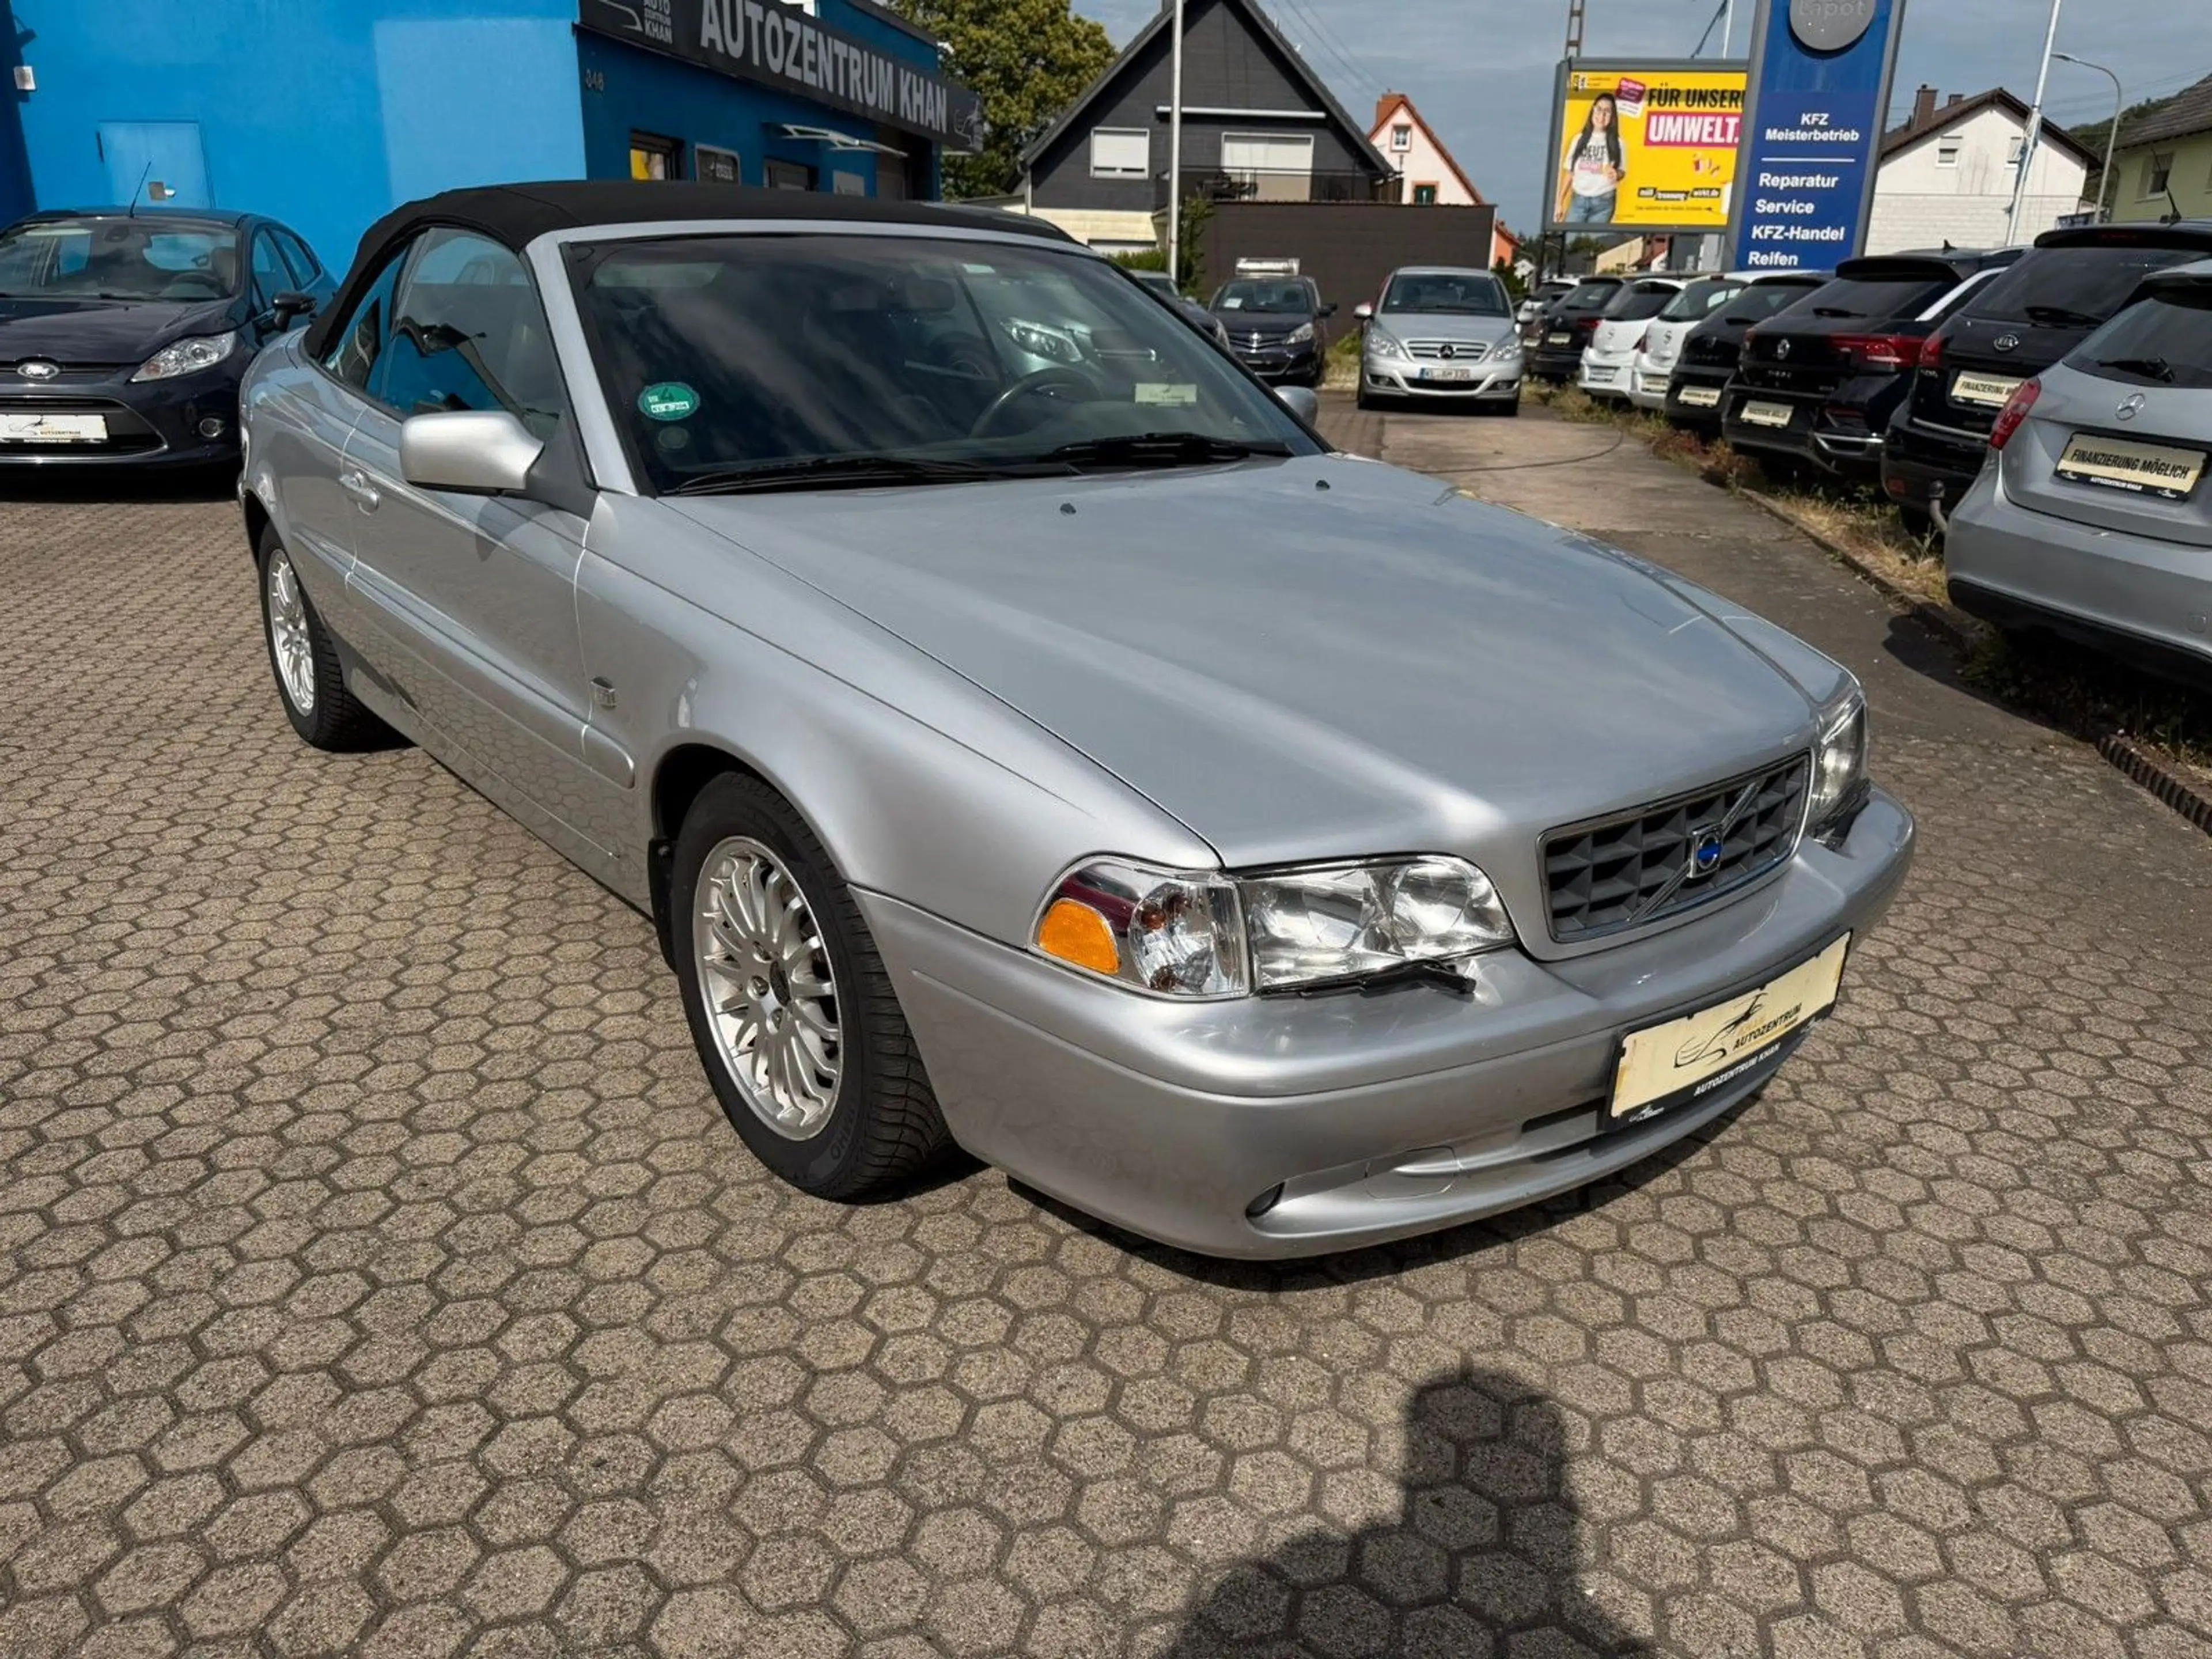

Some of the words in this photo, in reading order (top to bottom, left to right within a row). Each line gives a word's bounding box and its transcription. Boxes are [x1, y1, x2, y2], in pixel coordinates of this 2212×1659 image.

[645, 18, 673, 44] KHAN
[700, 0, 893, 113] AUTOZENTRUM
[899, 68, 948, 133] KHAN
[1648, 82, 1681, 107] FÜR
[1649, 114, 1740, 143] UMWELT.
[1800, 113, 1829, 126] KFZ
[1765, 128, 1859, 141] Meisterbetrieb
[1759, 173, 1839, 190] Reparatur
[1755, 199, 1815, 214] Service
[1751, 225, 1844, 241] KFZ-Handel
[1748, 251, 1798, 266] Reifen
[2071, 449, 2139, 471] FINANZIERUNG
[2139, 458, 2191, 479] MÖGLICH
[1732, 1002, 1802, 1051] AUTOZENTRUM
[1694, 1056, 1758, 1096] AUTOZENTRUM
